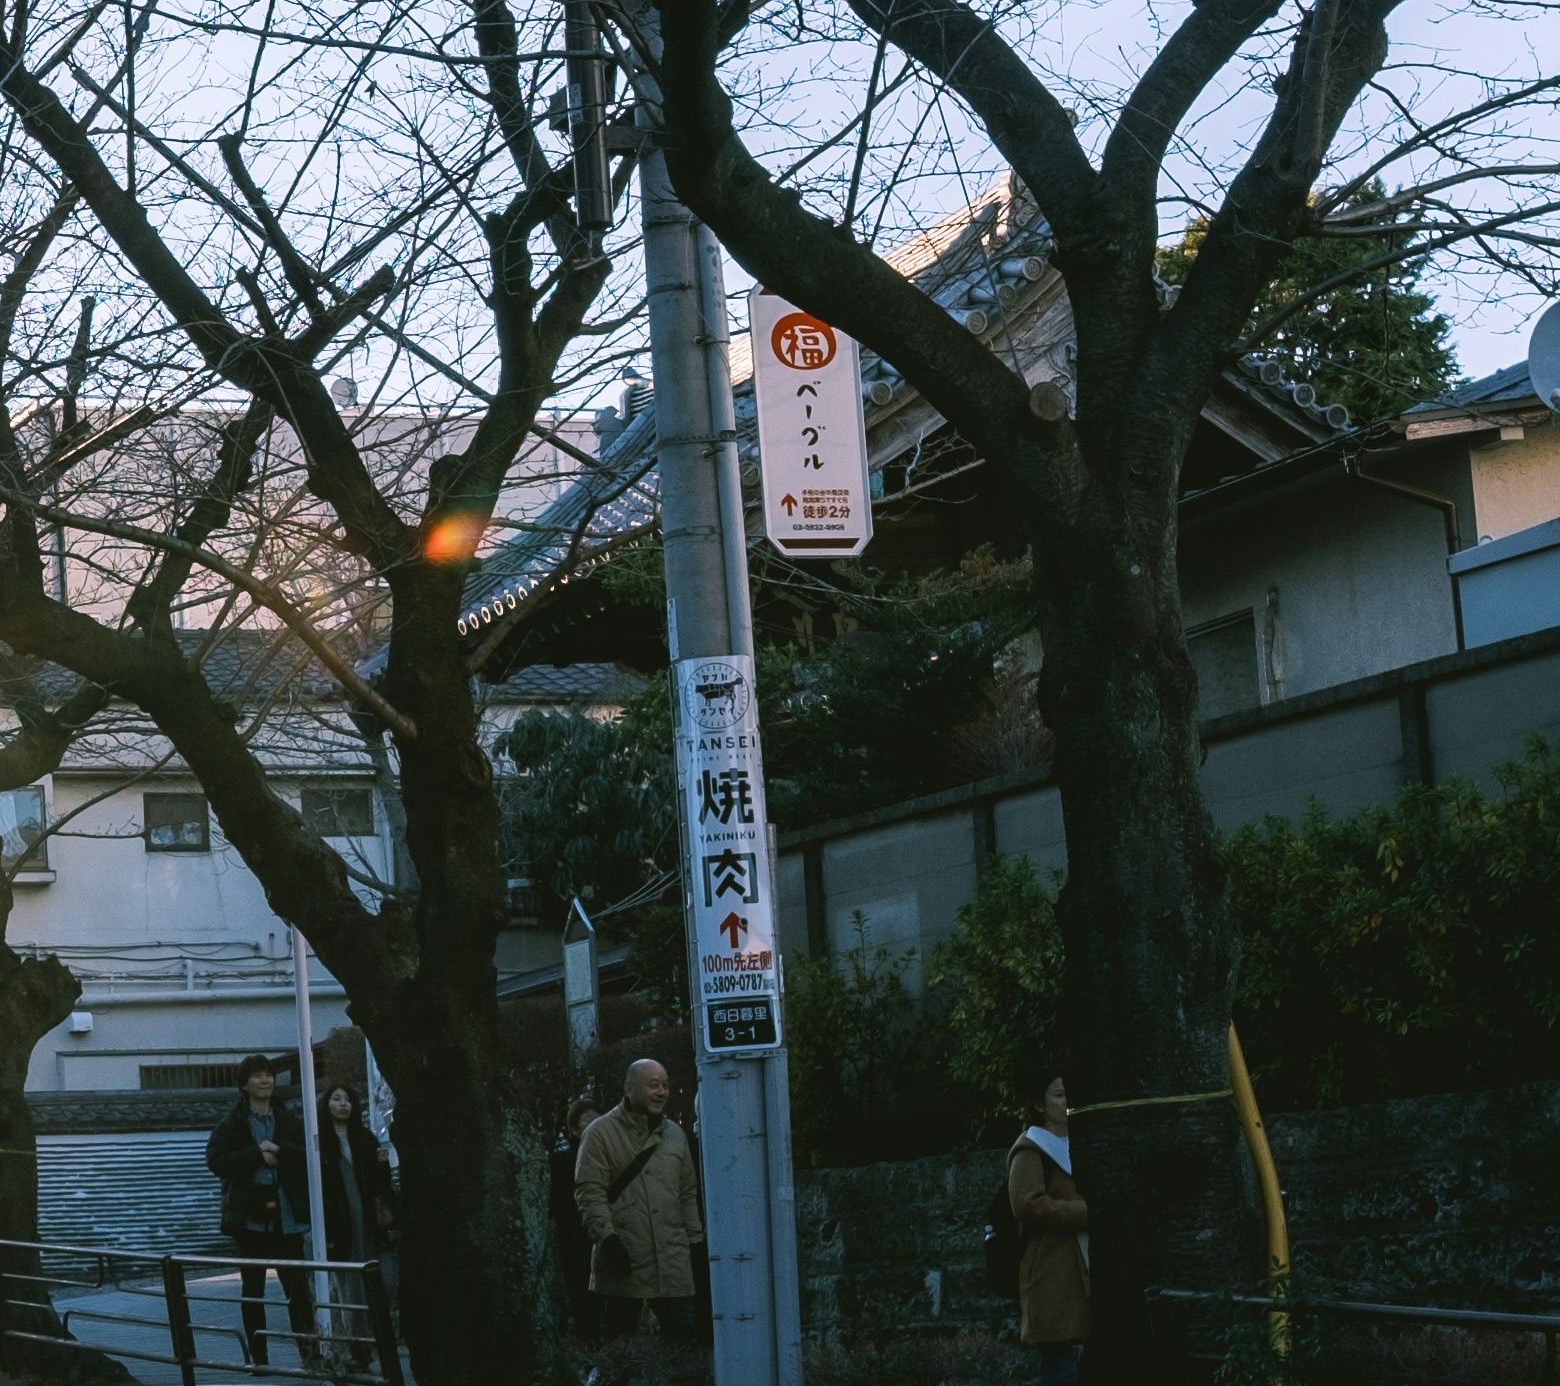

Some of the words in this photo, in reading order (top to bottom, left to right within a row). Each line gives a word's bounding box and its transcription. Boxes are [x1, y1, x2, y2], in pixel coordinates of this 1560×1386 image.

[784, 326, 824, 366] 福
[796, 380, 826, 470] ベーグル
[803, 505, 851, 519] 徒歩2分
[687, 735, 756, 753] TANSEI
[700, 830, 756, 844] YAKINIKU
[703, 950, 773, 973] 100m先左側
[713, 1006, 767, 1024] 西日暮里
[725, 1026, 756, 1041] 3-1
